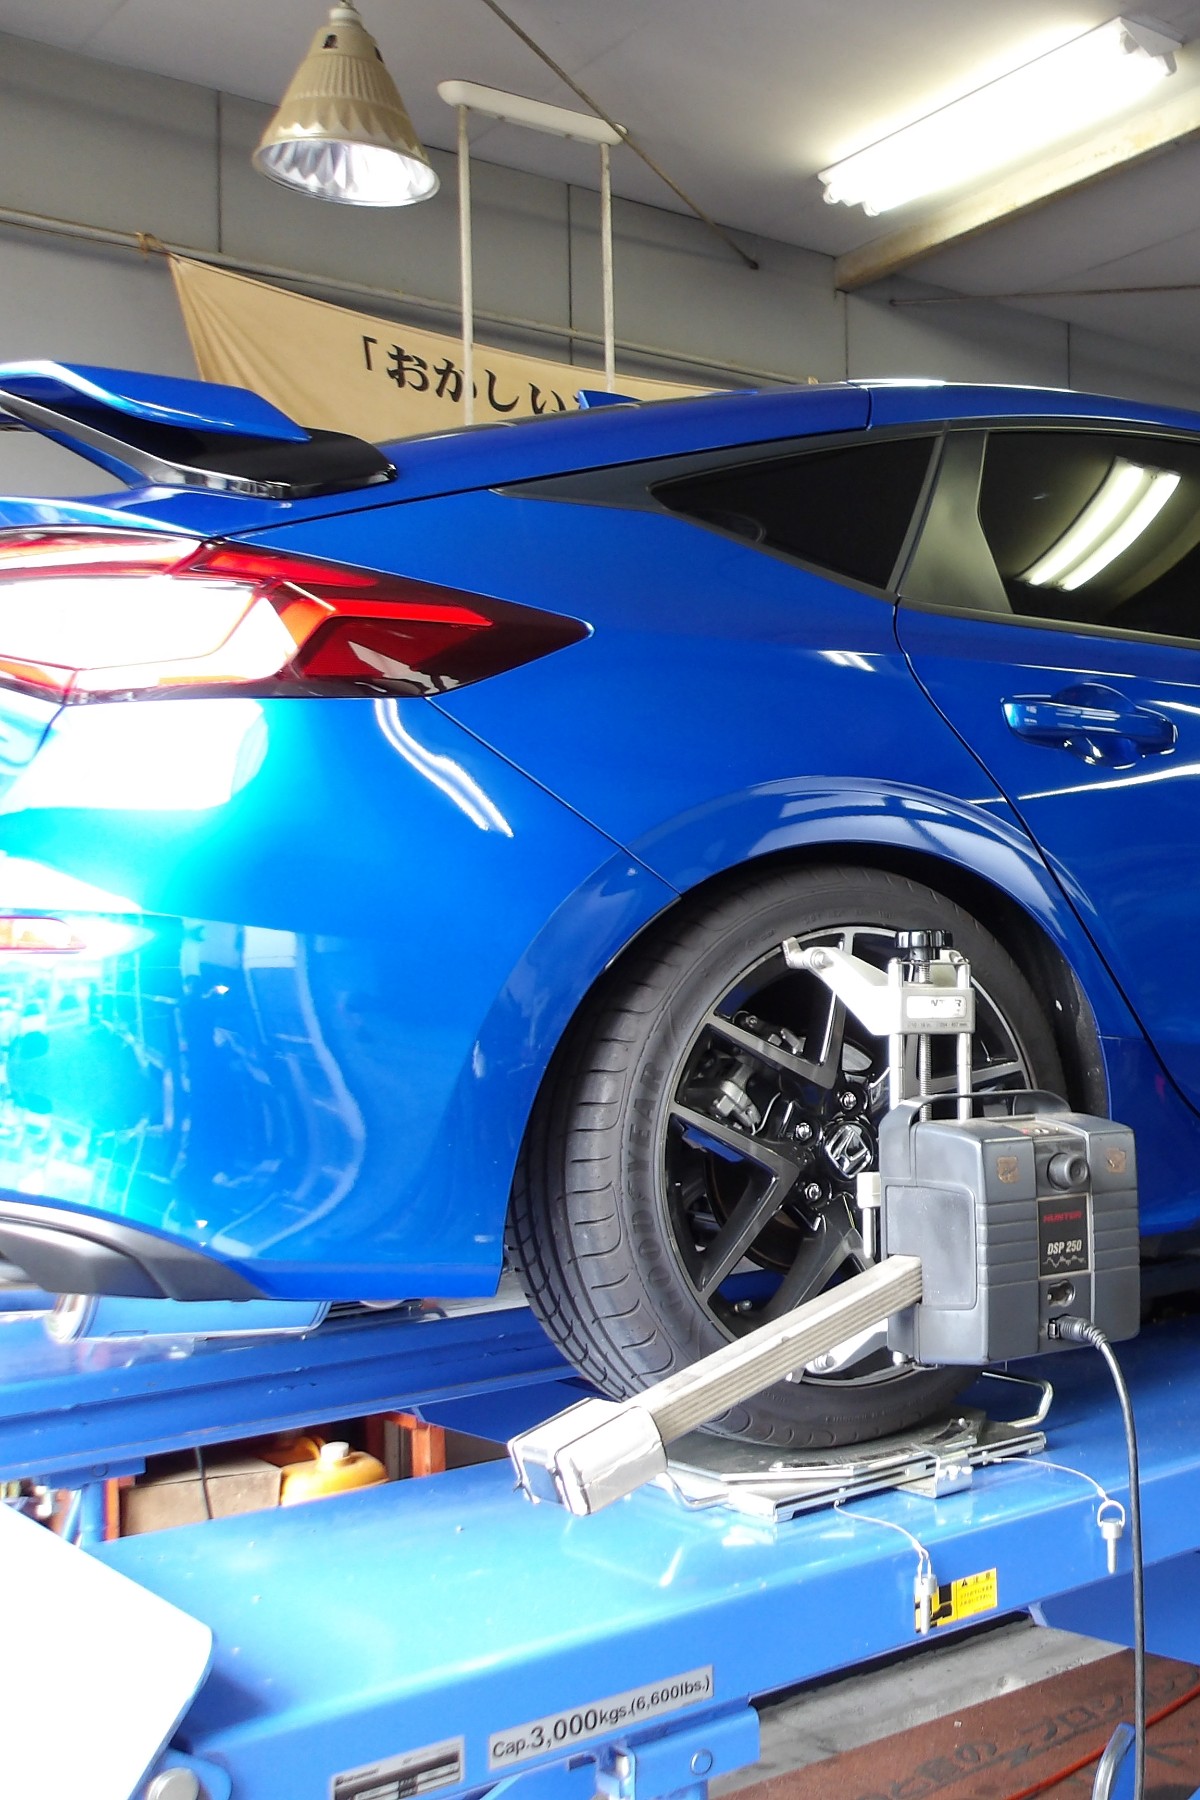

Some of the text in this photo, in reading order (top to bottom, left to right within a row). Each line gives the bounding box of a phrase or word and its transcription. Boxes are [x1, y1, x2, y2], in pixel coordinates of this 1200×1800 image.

[361, 334, 580, 415] 「おかしい
[1047, 1239, 1082, 1256] DSP 250
